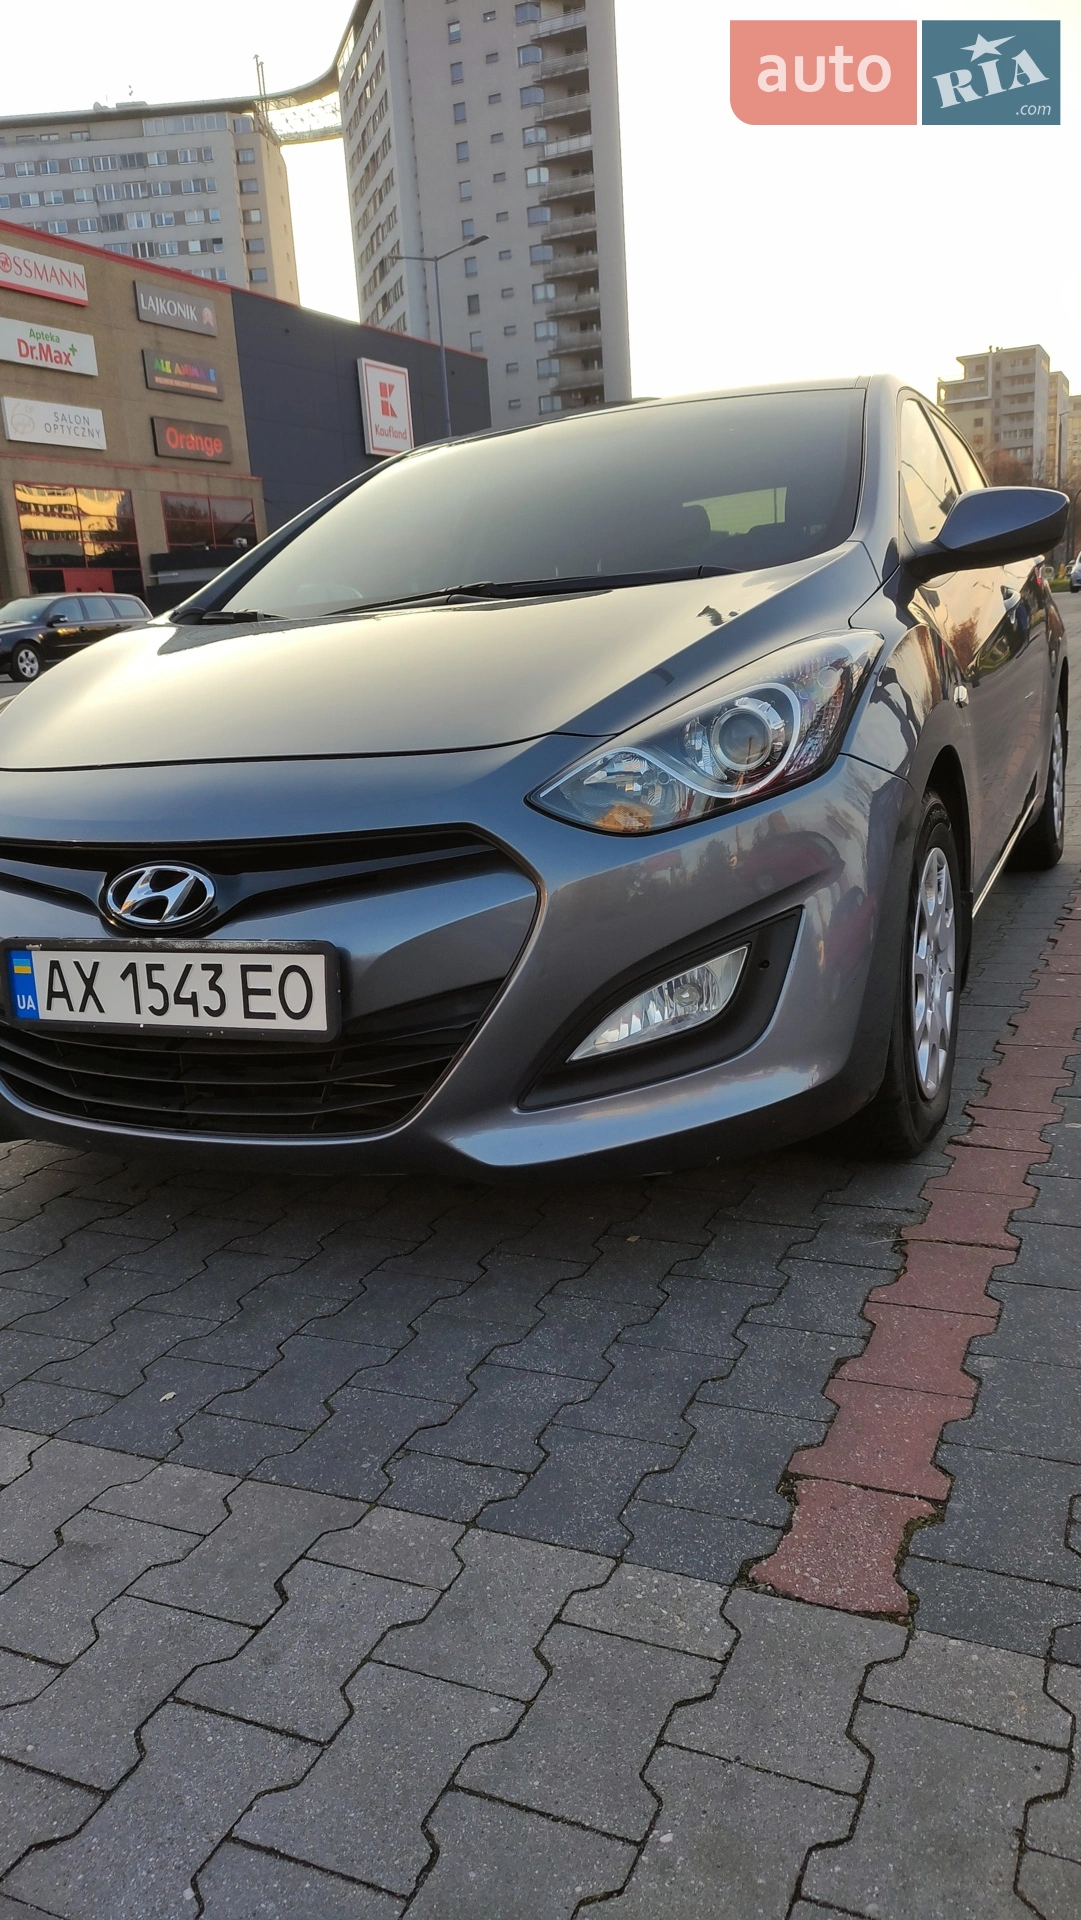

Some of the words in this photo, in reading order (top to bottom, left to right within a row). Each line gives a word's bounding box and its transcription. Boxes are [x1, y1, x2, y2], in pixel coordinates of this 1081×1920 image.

[140, 293, 198, 322] LAJKONIK
[29, 328, 61, 343] Apteka
[17, 338, 73, 367] Dr.Max
[54, 411, 90, 426] SALON
[44, 423, 101, 439] OPTYCZNY
[374, 424, 408, 440] Kaufland
[165, 426, 223, 457] Orange
[45, 959, 106, 1014] AX
[119, 962, 227, 1018] 1543
[240, 964, 314, 1021] EO
[16, 994, 37, 1011] UA
